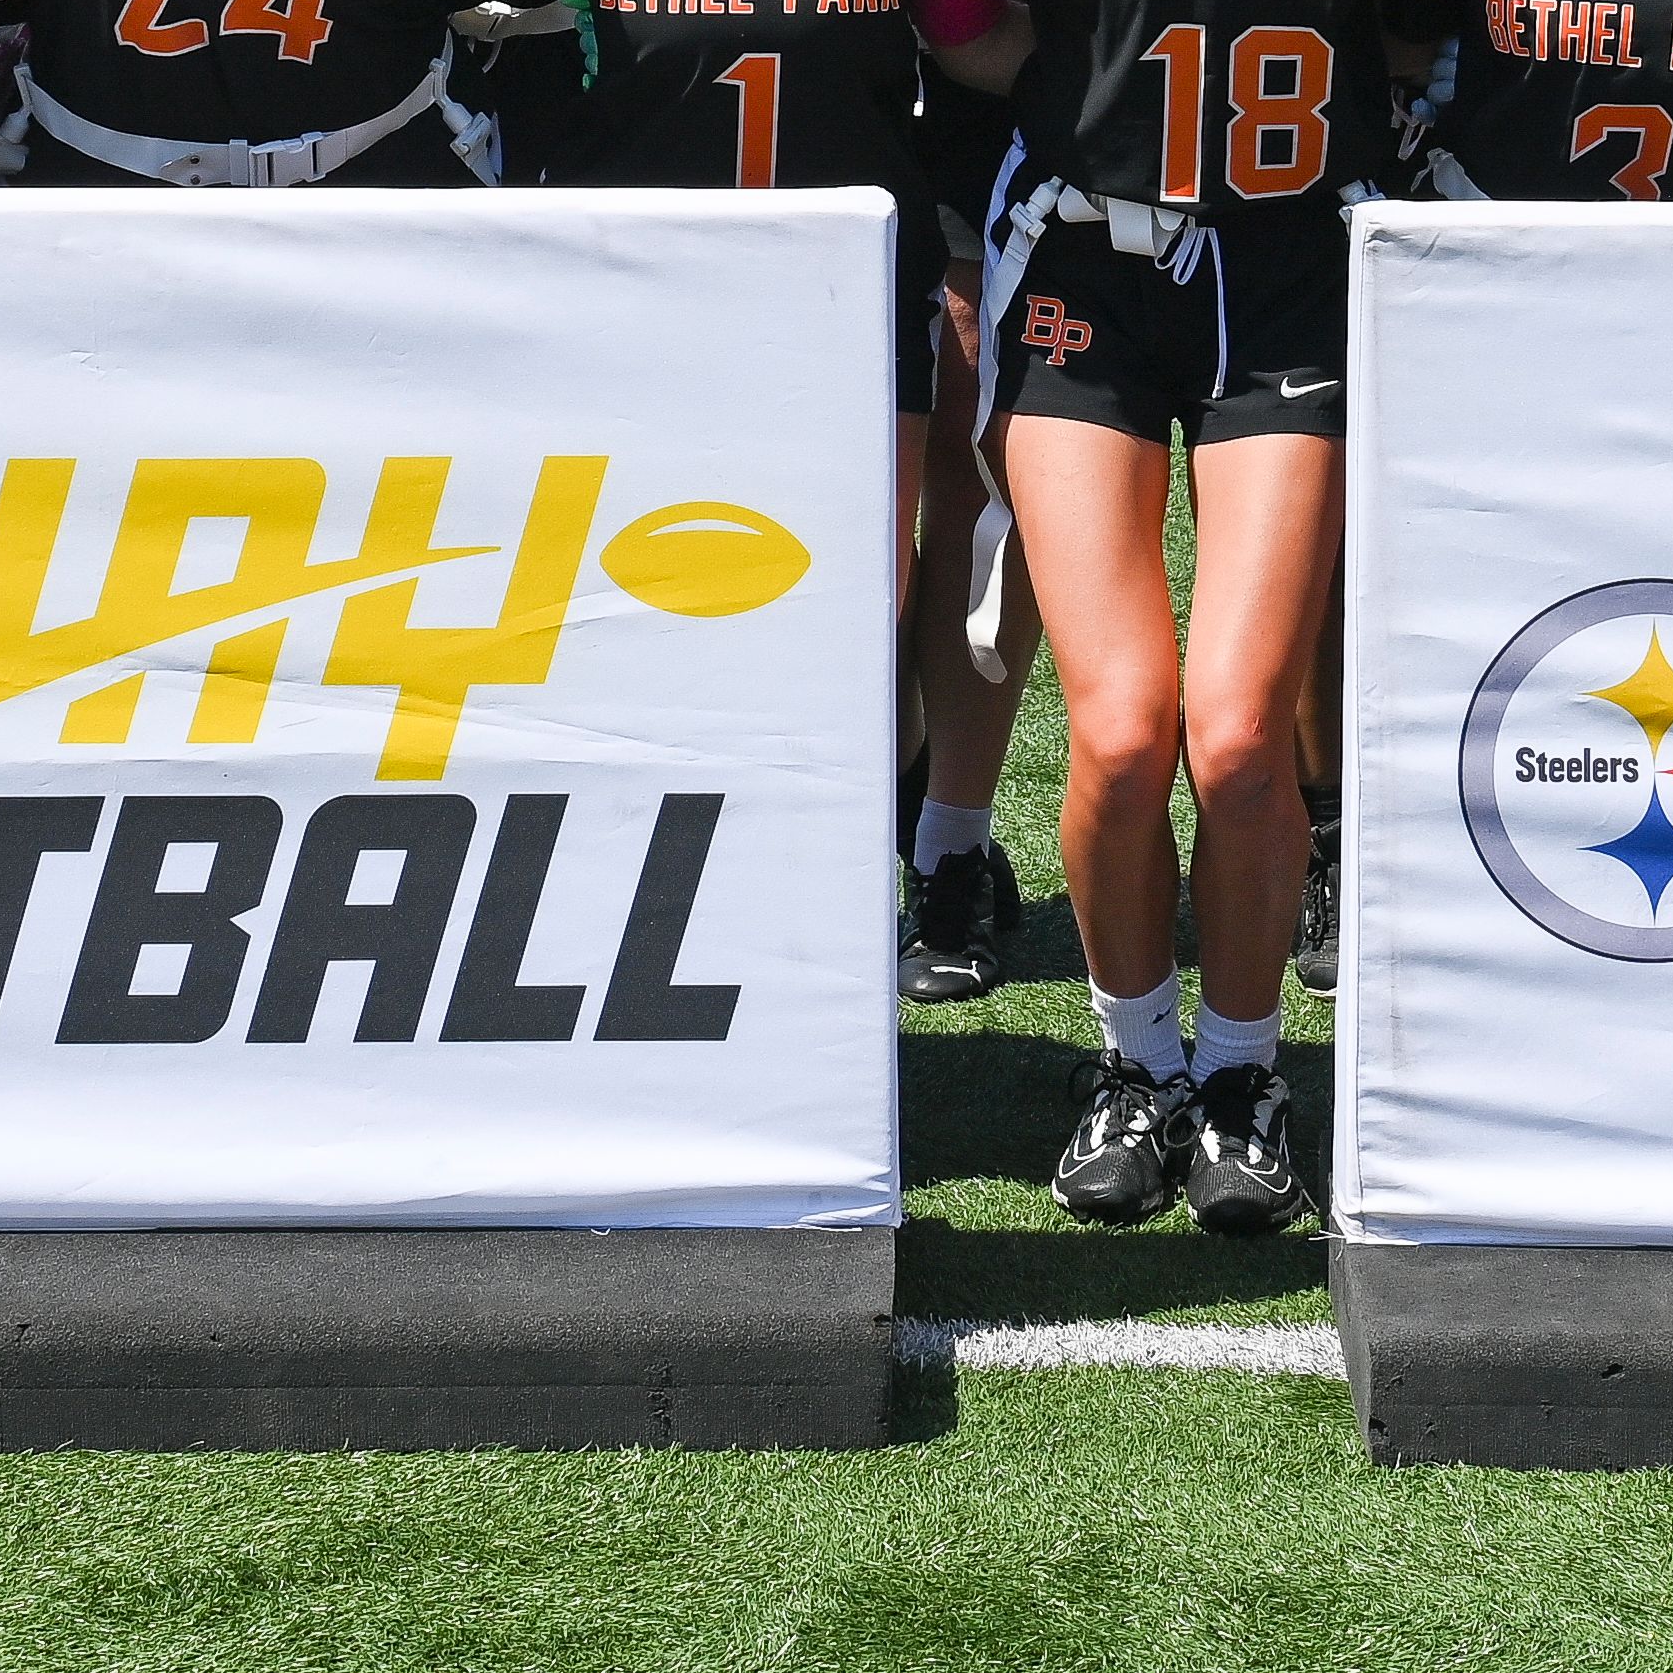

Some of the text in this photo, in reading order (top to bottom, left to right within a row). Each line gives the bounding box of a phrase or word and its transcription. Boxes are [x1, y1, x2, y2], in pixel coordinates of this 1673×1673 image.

[712, 52, 781, 188] 1
[1139, 23, 1335, 202] 18
[1021, 294, 1093, 366] BP
[1515, 747, 1639, 783] Steelers
